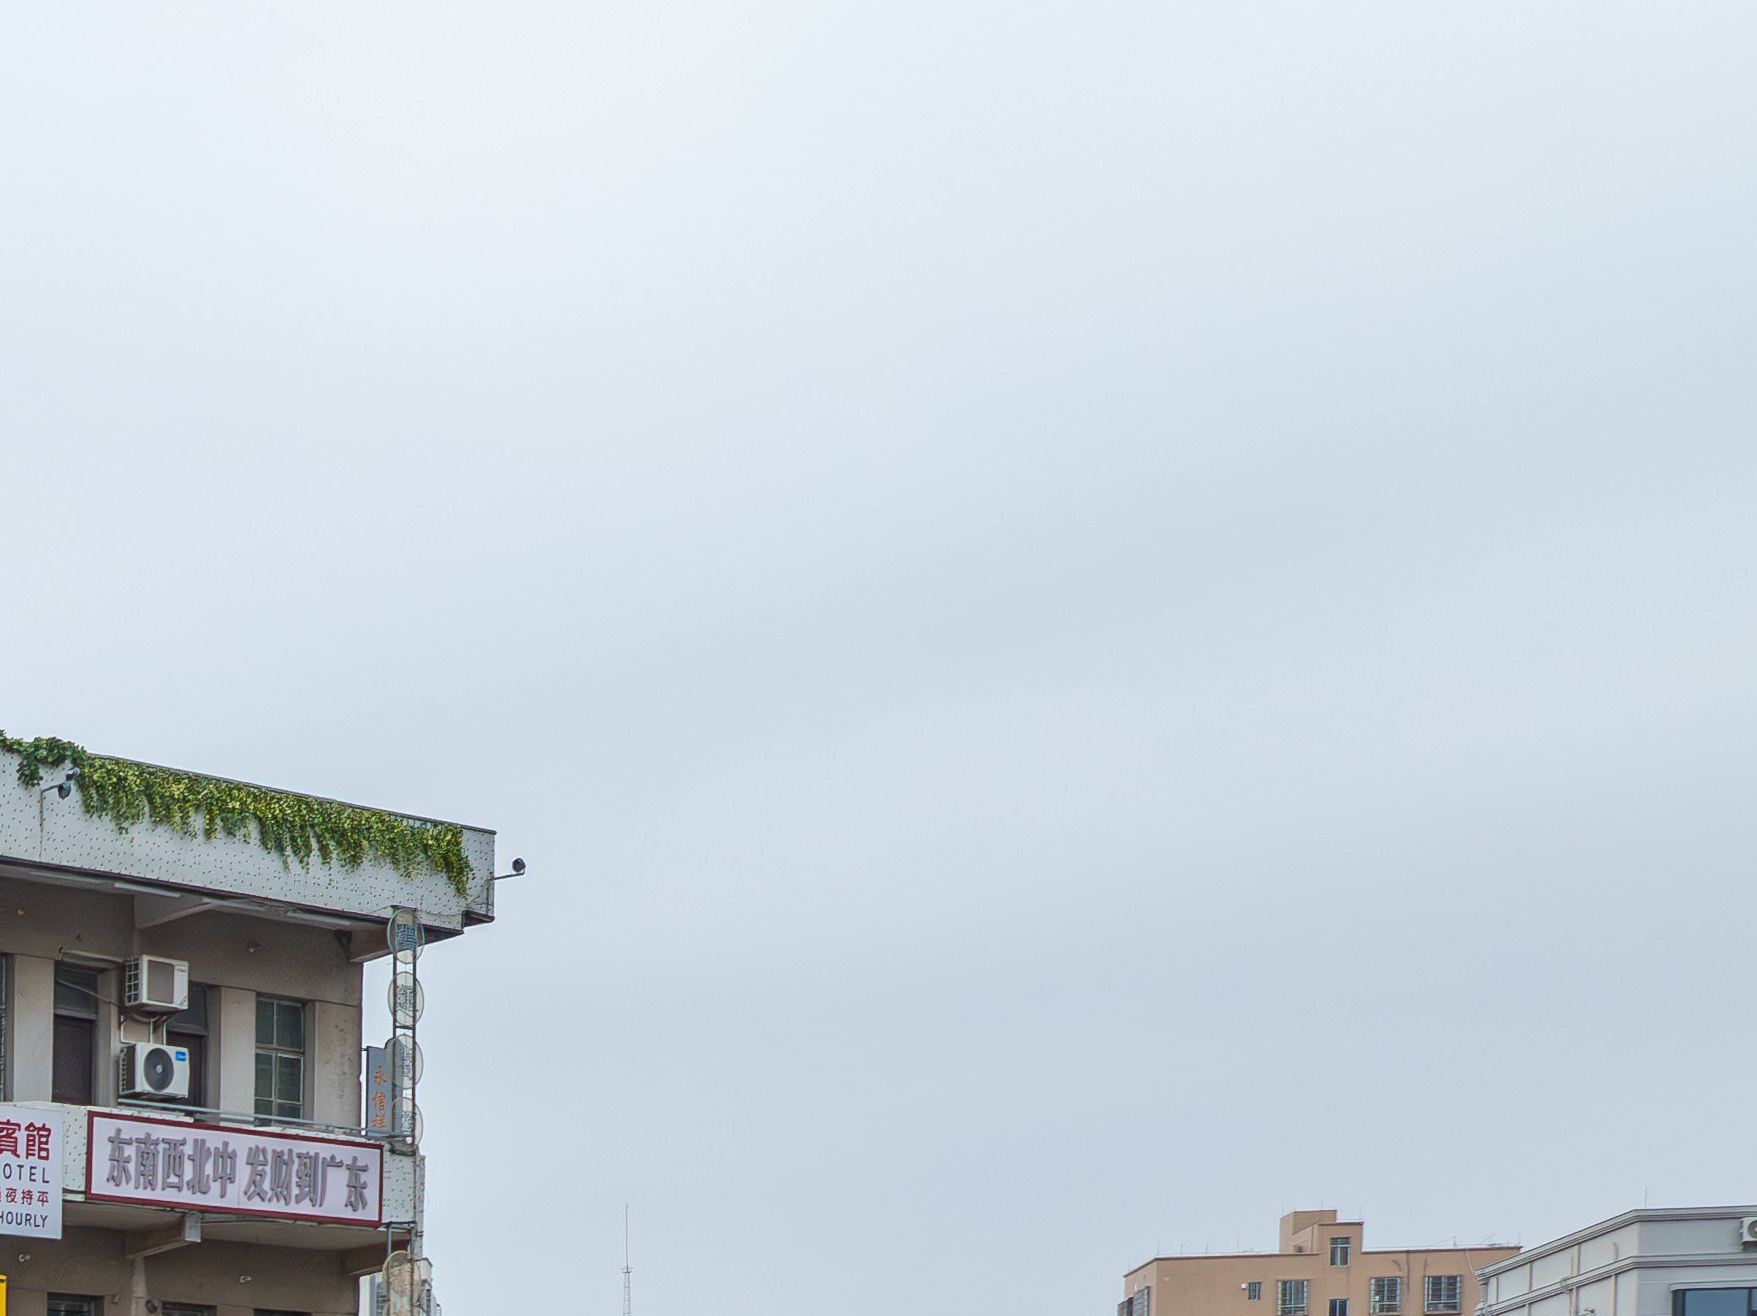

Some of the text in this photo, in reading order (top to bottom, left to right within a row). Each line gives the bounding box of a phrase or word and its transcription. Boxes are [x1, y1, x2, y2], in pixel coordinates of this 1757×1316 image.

[104, 1128, 370, 1215] 东南西北中 发财到广东
